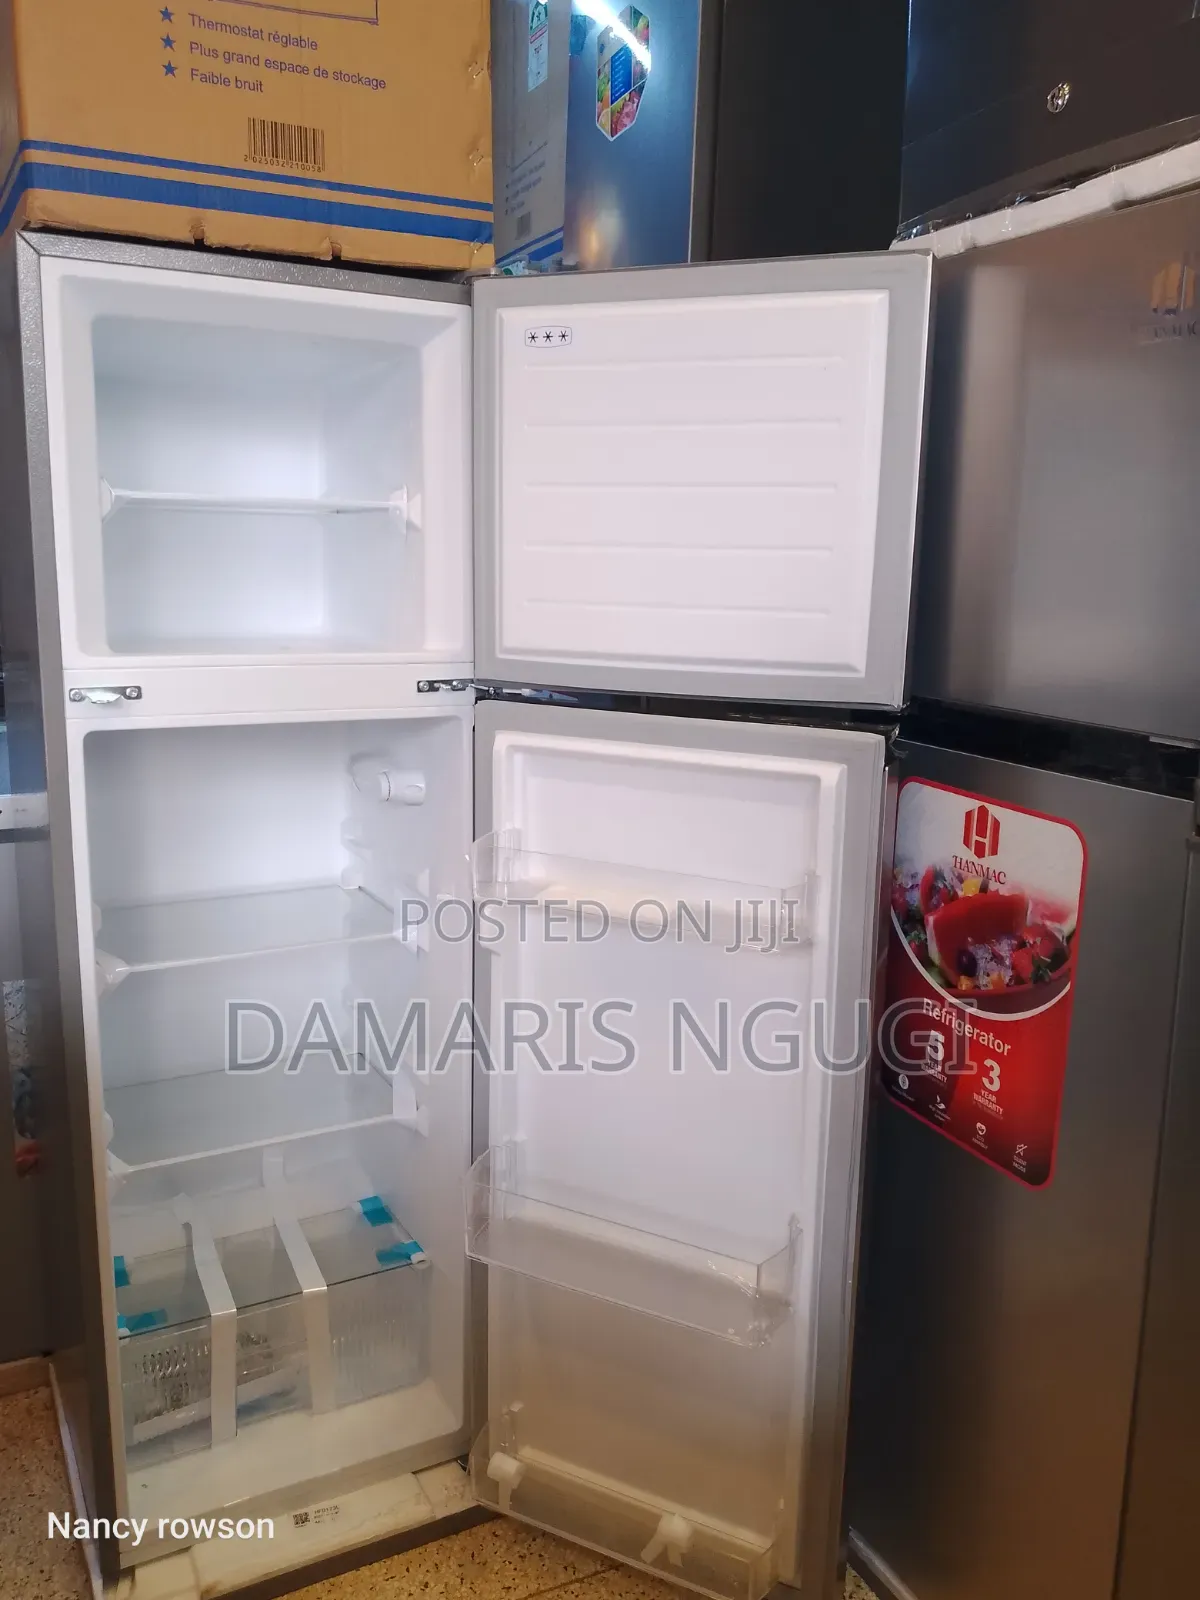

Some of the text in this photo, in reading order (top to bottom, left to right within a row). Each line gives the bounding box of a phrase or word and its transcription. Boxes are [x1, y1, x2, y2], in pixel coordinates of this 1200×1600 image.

[188, 13, 318, 51] Thermostat réglable
[190, 41, 386, 91] Plus grand espace de stockage
[190, 68, 264, 93] Faible bruit
[952, 855, 1007, 885] HANMAC
[922, 998, 1012, 1056] Refrigerator
[927, 1029, 945, 1061] 5
[982, 1058, 1001, 1092] 3
[973, 1092, 1004, 1115] WARRANTY
[981, 1089, 997, 1104] YEAR
